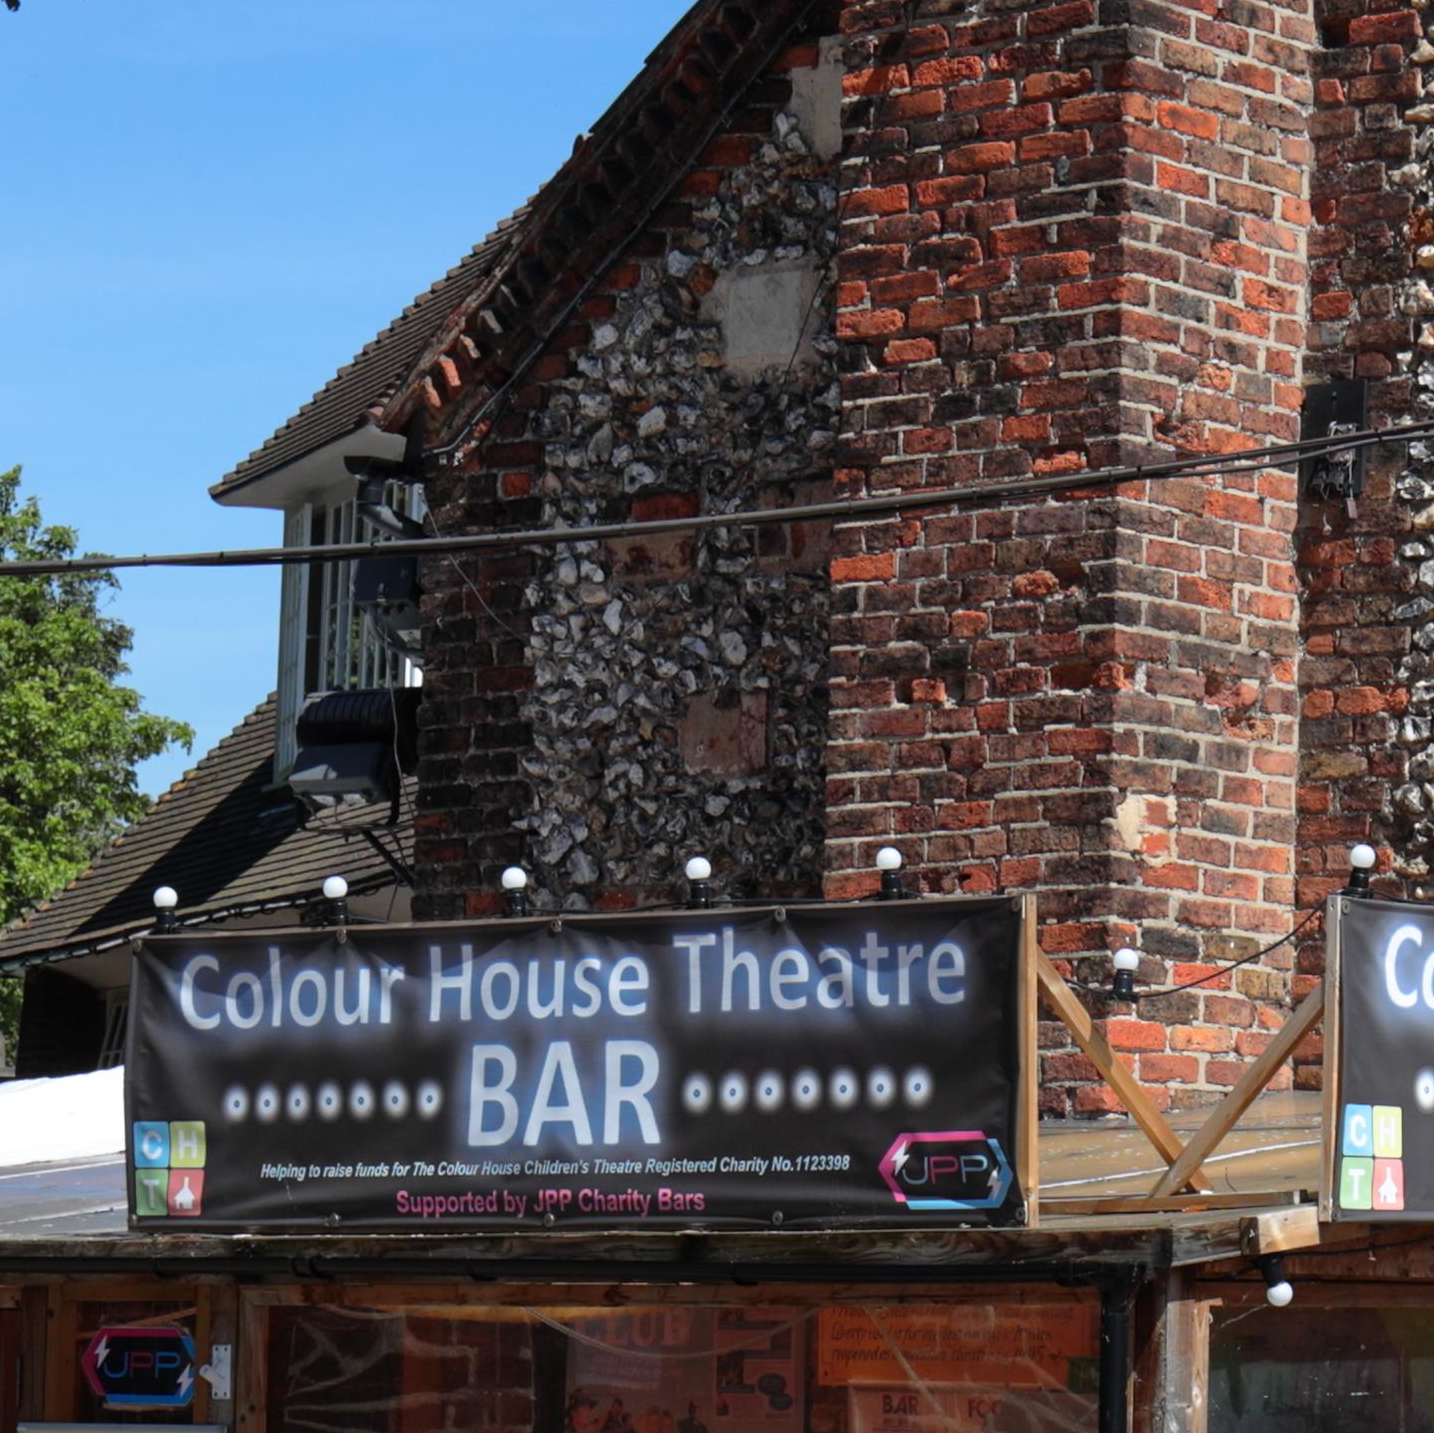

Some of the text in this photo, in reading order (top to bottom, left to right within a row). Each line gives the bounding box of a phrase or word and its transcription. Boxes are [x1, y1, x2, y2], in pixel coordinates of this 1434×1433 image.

[179, 926, 966, 1032] Colour House Theatre
[467, 1040, 663, 1148] BAR
[261, 1155, 850, 1181] Helping to raise funds for The Colour House Children's Theatre Registered Charity No.1123398
[902, 1156, 990, 1186] JPP
[396, 1189, 705, 1217] Supported by JPP Charity Bars
[103, 1352, 179, 1378] JPP
